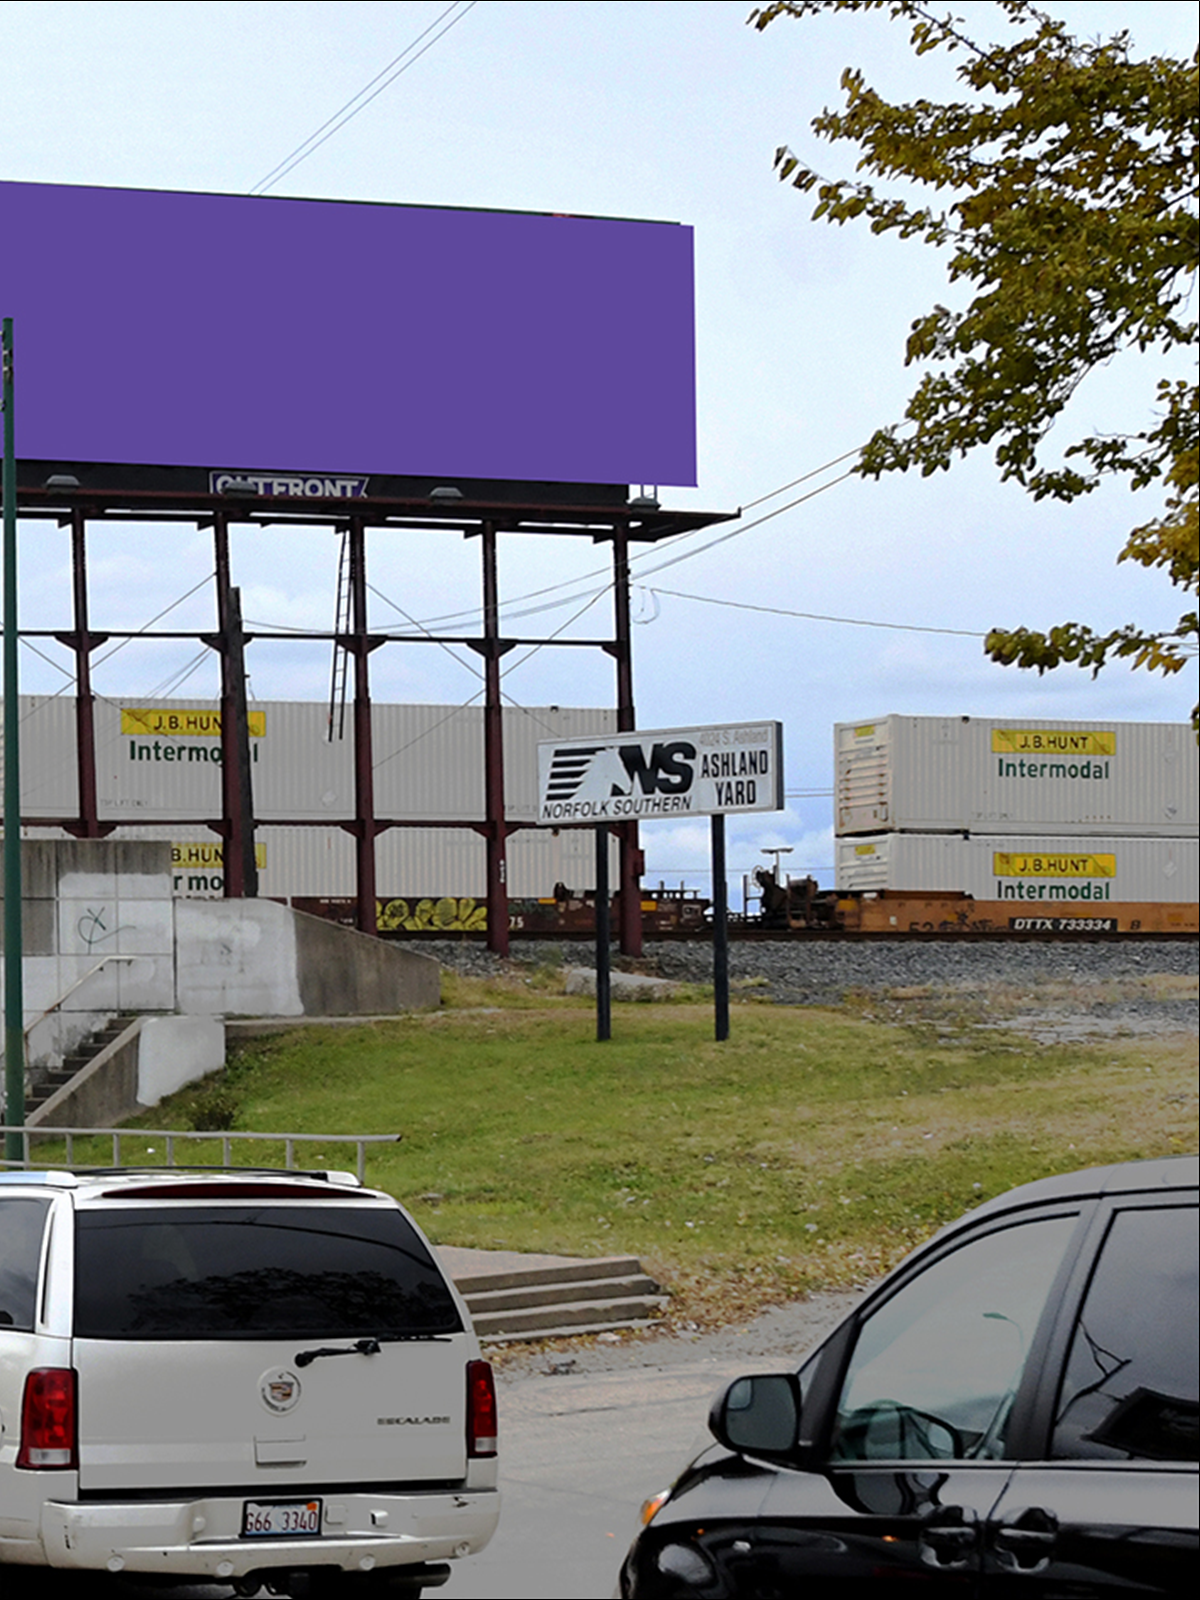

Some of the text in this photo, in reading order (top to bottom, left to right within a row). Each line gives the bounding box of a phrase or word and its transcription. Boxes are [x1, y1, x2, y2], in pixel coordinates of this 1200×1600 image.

[216, 474, 359, 498] OTFRONT
[130, 740, 259, 763] Intermol
[701, 749, 769, 779] ASHLAND
[998, 758, 1109, 780] Intermodal
[714, 779, 757, 807] YARD
[542, 800, 610, 820] NORFOLK
[613, 796, 693, 816] SOUTHERN
[997, 880, 1110, 900] Intermodal
[1013, 918, 1112, 931] DTTX 733334
[377, 1415, 451, 1426] ESCALADE
[281, 1510, 319, 1532] 3340
